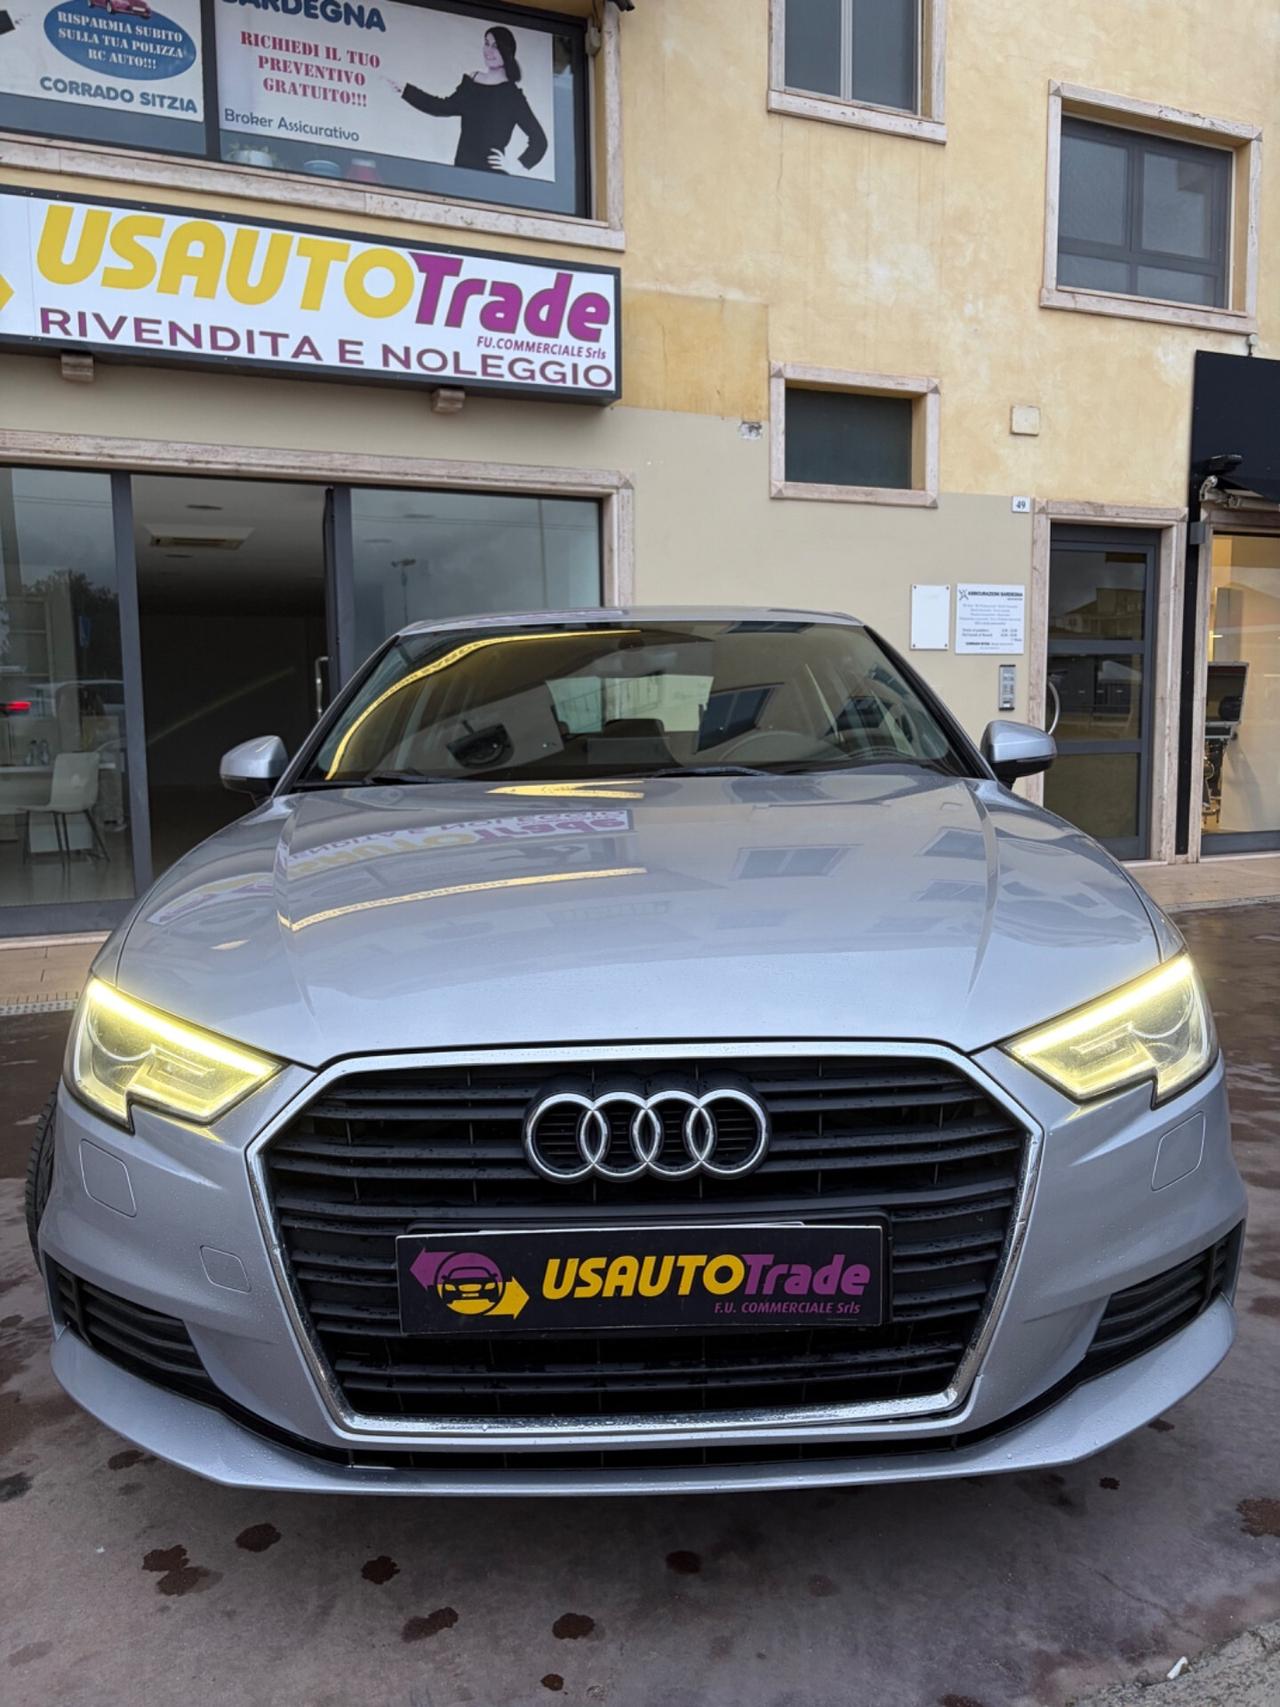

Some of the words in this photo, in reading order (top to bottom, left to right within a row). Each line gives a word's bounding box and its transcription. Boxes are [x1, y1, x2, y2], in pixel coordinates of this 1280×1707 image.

[57, 10, 133, 34] RISPARMIA
[135, 23, 183, 43] SUBITO
[221, 0, 387, 32] DEGNA
[58, 28, 100, 44] SULLA
[102, 35, 129, 50] TUA
[131, 41, 184, 59] POLIZZA
[88, 48, 106, 62] RC
[109, 52, 157, 70] AUTO!!!
[240, 31, 320, 58] RICHIEDI
[324, 46, 342, 62] IL
[346, 50, 381, 69] TUO
[258, 55, 366, 86] PREVENTIVO
[39, 76, 135, 104] CORRADO
[139, 91, 198, 114] SITZIA
[263, 77, 368, 107] GRATUITO!!!
[224, 108, 274, 129] Broker
[277, 116, 360, 143] Assicurativo
[37, 204, 611, 343] USAUTOTrade
[40, 307, 324, 361] RIVENDITA
[338, 338, 364, 365] E
[382, 343, 613, 388] NOLEGGIO
[476, 335, 583, 358] FU.COMMERCIALE
[585, 347, 607, 360] Srls
[542, 1254, 871, 1299] USAUTOTrade
[714, 1301, 737, 1314] F.U.
[741, 1301, 834, 1314] COMMERCIALE
[836, 1301, 861, 1314] Srls
